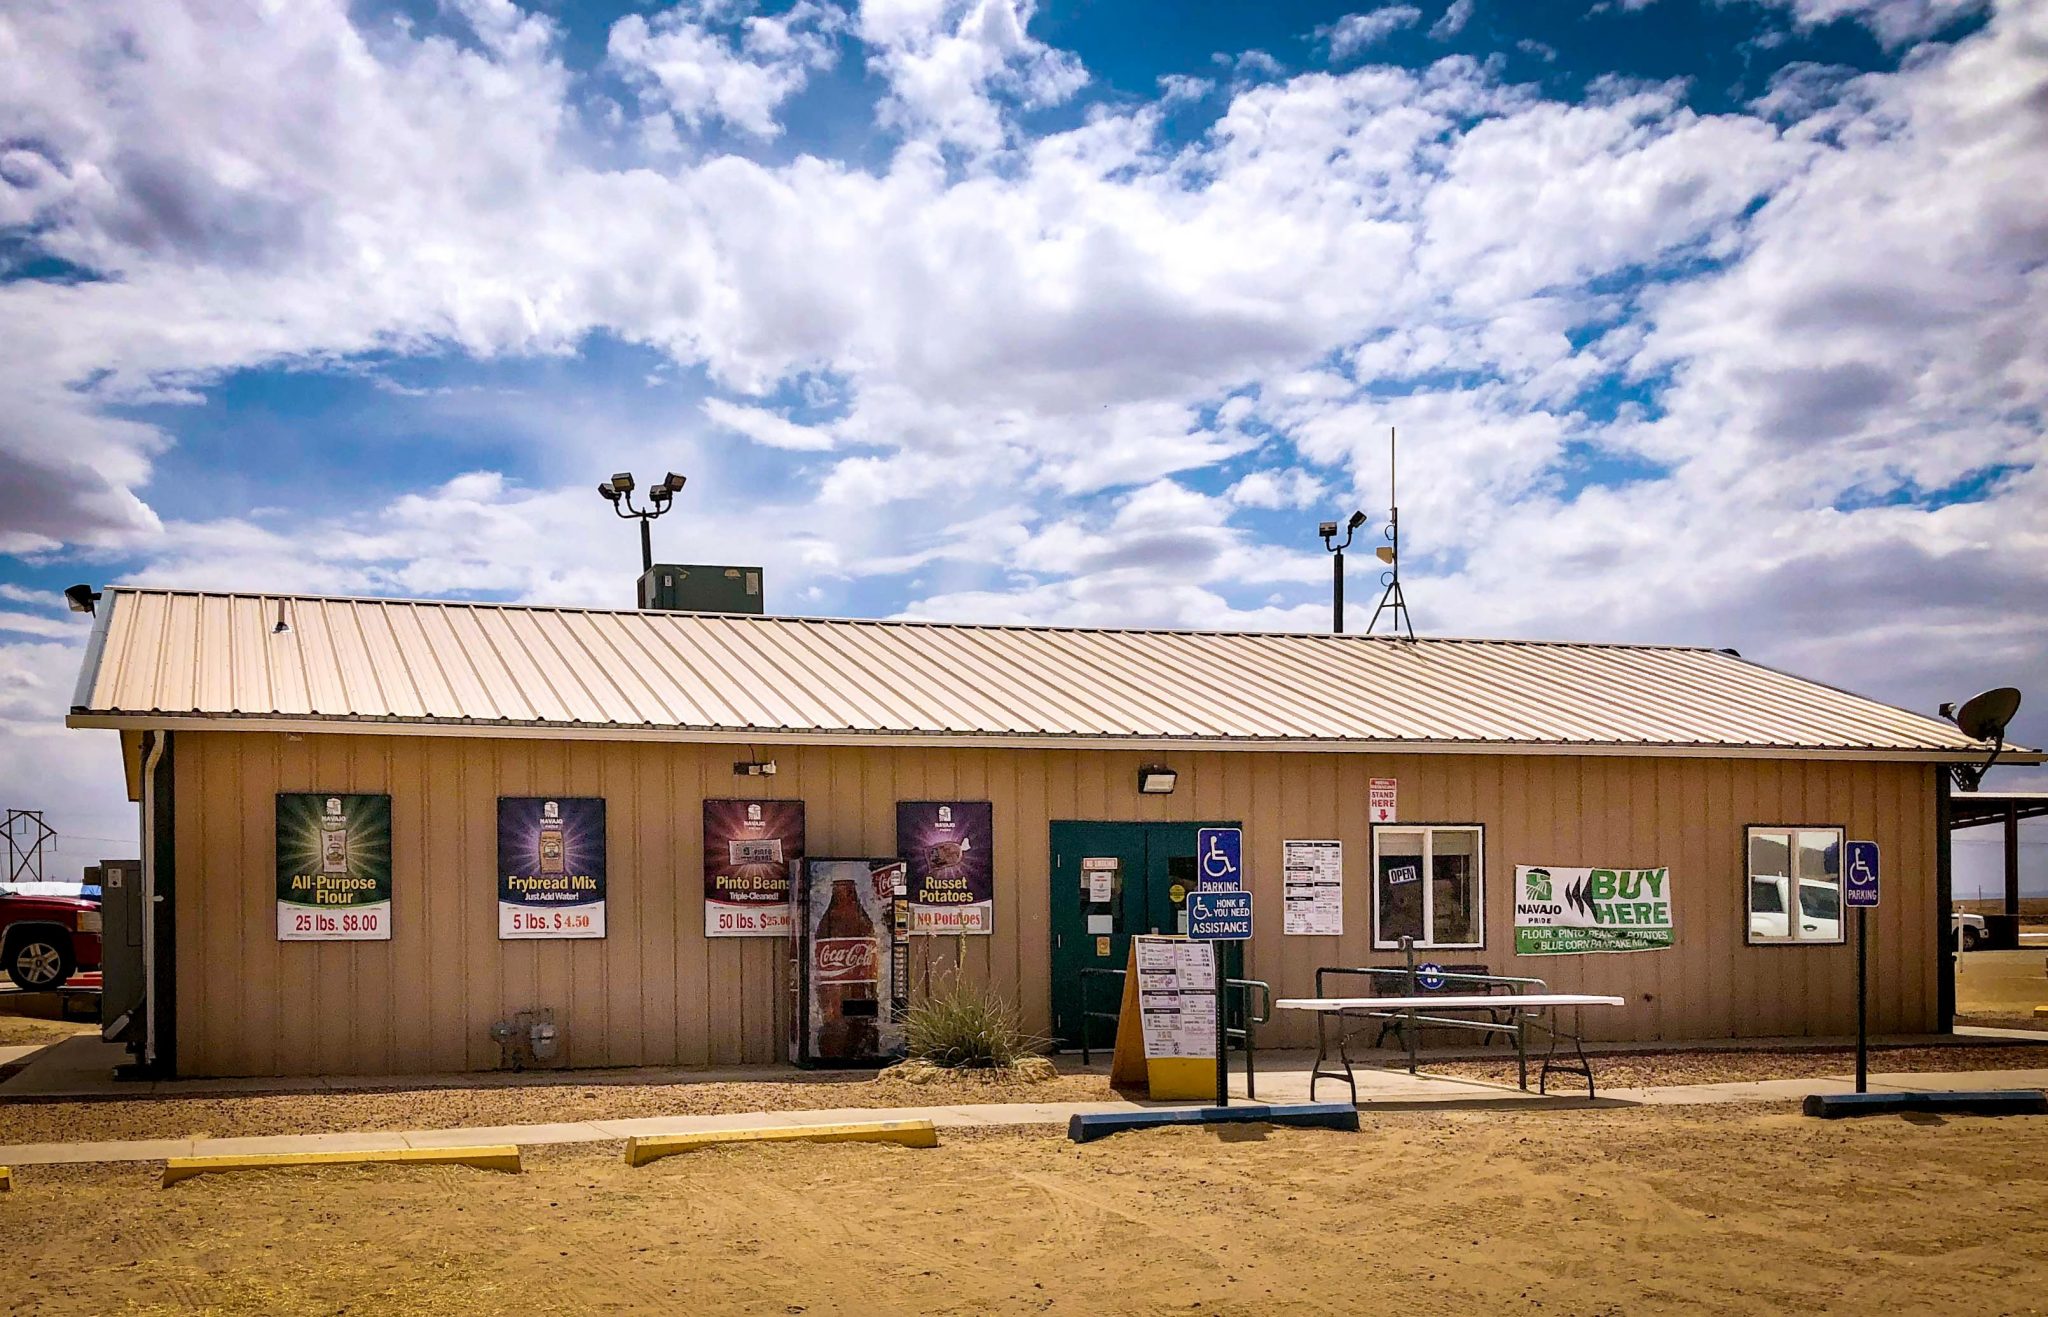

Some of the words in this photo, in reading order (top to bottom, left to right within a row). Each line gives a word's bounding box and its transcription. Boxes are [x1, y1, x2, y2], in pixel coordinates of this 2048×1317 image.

[1371, 799, 1395, 807] HERE
[1390, 867, 1415, 882] OPEN
[291, 875, 377, 892] All-Purpose
[508, 875, 569, 892] Frybread
[572, 875, 597, 890] Mix
[716, 875, 750, 890] Pinto
[925, 876, 968, 890] Russet
[1202, 881, 1239, 892] PARKING
[1592, 868, 1667, 900] BUY
[316, 890, 354, 904] Flour
[525, 892, 540, 901] Just
[540, 892, 555, 901] Add
[555, 892, 579, 901] Water!
[729, 891, 779, 901] Triple-Cleaned!
[919, 889, 974, 903] Potatoes
[1847, 889, 1878, 900] PARKING
[1216, 899, 1236, 908] HONK
[1238, 899, 1246, 907] IF
[1517, 903, 1562, 915] NAVAJO
[917, 912, 932, 925] NO
[1213, 908, 1228, 917] YOU
[1230, 908, 1250, 917] NEED
[1595, 902, 1669, 925] HERE
[295, 914, 312, 931] 25
[316, 914, 339, 931] lbs.
[343, 914, 378, 932] $8.00
[513, 914, 521, 930] 5
[526, 913, 550, 930] lbs.
[719, 913, 733, 929] 50
[736, 912, 757, 929] lbs.
[1192, 922, 1249, 934] ASSISTANCE
[1521, 929, 1552, 939] FLOUR
[1558, 929, 1586, 938] PINTO
[1540, 941, 1564, 950] BLUE
[1565, 940, 1590, 950] CORN
